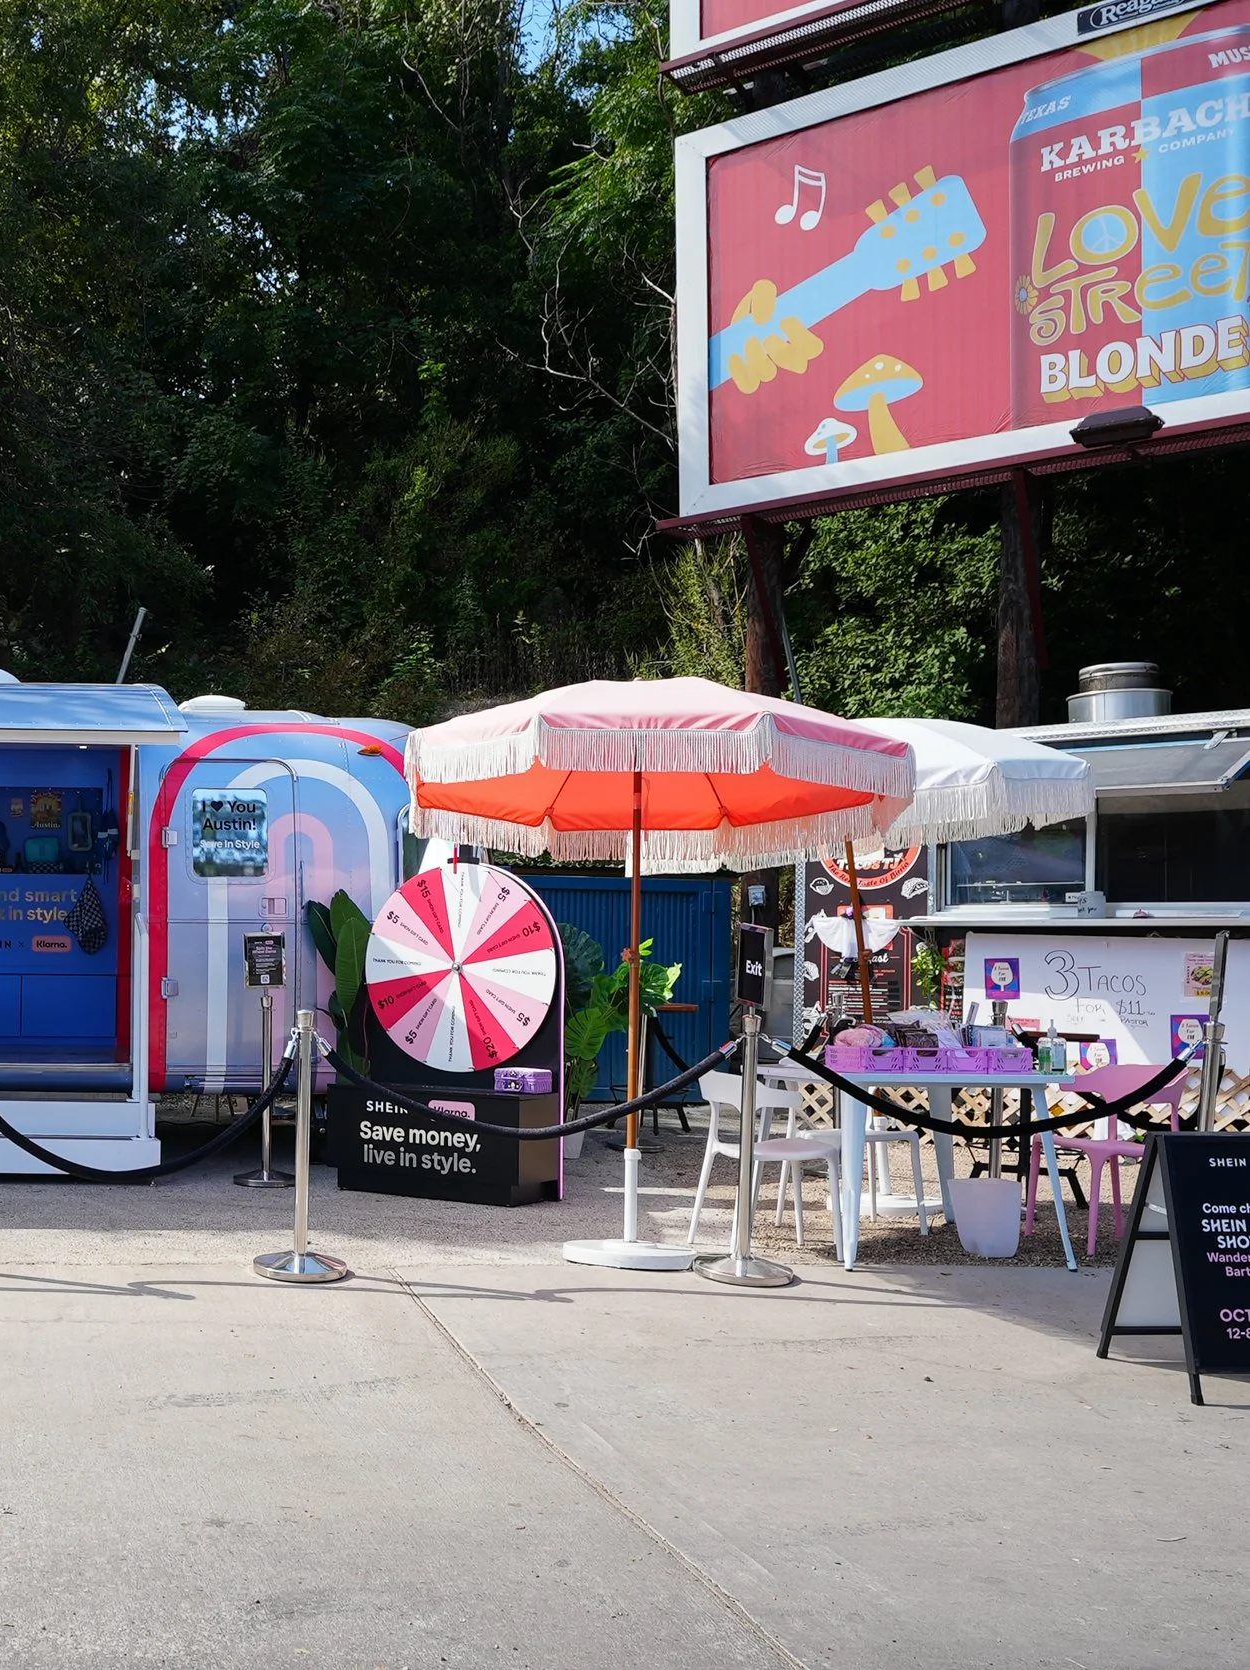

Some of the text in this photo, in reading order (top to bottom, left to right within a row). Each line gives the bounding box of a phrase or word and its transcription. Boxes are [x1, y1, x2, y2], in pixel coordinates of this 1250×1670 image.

[1021, 95, 1071, 125] TEXAS
[1054, 127, 1235, 182] BREWING COMPANY
[1039, 314, 1249, 402] BLONDE
[202, 800, 256, 813] I You
[203, 818, 257, 831] Austin!
[200, 839, 261, 850] Save In Style
[416, 878, 431, 898] $15
[496, 886, 511, 902] $5
[9, 906, 23, 921] in
[27, 906, 68, 924] style
[385, 910, 400, 924] $5
[520, 920, 541, 938] $10
[36, 940, 68, 949] Klarna.
[745, 959, 763, 977] Exit
[1044, 950, 1147, 1001] 3 TACOS
[376, 994, 395, 1009] $10
[515, 1011, 531, 1027] $5
[403, 1029, 418, 1045] $5
[481, 1035, 498, 1059] $20
[359, 1120, 482, 1153] Save money,
[363, 1143, 477, 1175] live in style.
[1208, 1157, 1247, 1167] SHEIN
[1202, 1203, 1237, 1214] Come
[1201, 1219, 1247, 1232] SHEIN
[1217, 1236, 1250, 1249] SHO
